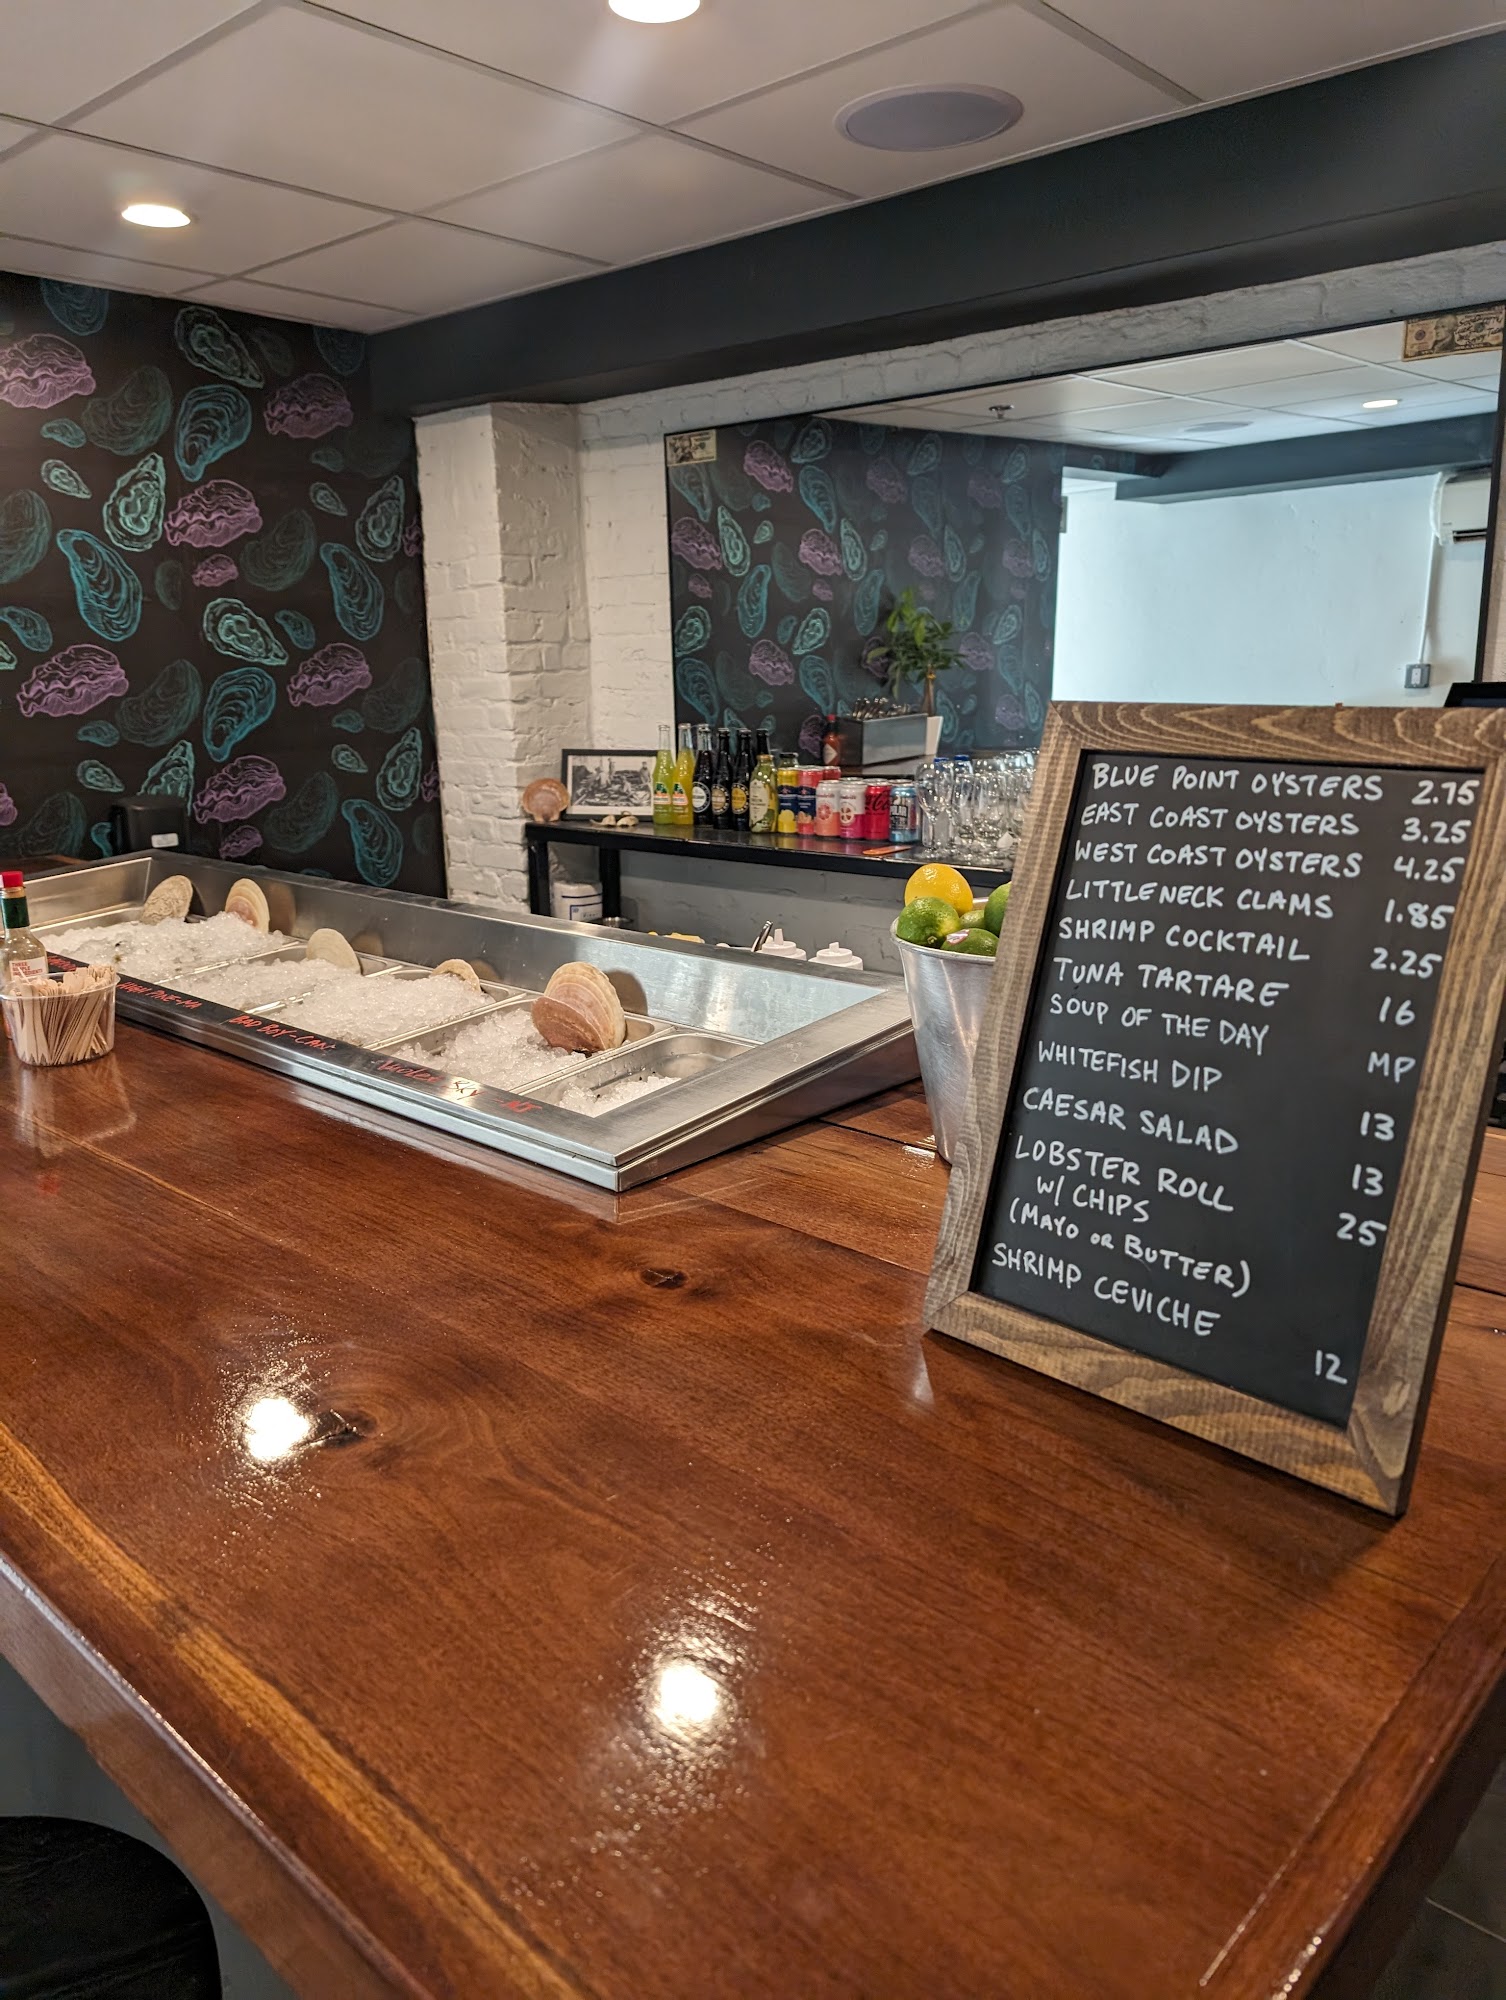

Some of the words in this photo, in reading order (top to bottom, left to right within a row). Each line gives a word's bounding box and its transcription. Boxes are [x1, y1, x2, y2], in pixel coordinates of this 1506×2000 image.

[1092, 762, 1160, 790] BLUE
[1171, 765, 1240, 791] POINT
[1251, 770, 1384, 802] OYSTERS
[1411, 779, 1481, 806] 2.75
[1080, 801, 1140, 826] EAST
[1149, 805, 1229, 829] COAST
[1235, 810, 1360, 836] OYSTERS
[1401, 816, 1472, 844] 3.25
[1074, 839, 1139, 864] WEST
[1146, 843, 1227, 867] COAST
[1235, 847, 1363, 878] OYSTERS
[1393, 855, 1466, 884] 4.25
[1065, 878, 1225, 909] LITTLENECK
[1236, 888, 1334, 919] CLAMS
[1384, 898, 1456, 930] 1.85
[1058, 916, 1156, 943] SHRIMP
[1165, 924, 1311, 961] COCKTAIL
[1053, 956, 1125, 987] TUNA
[1137, 963, 1290, 1007] TARTARE
[1370, 947, 1443, 979] 2.25
[1049, 993, 1109, 1025] SOUP
[1120, 1006, 1153, 1028] OF
[1160, 1012, 1211, 1038] THE
[1219, 1019, 1270, 1056] DAY
[1379, 996, 1415, 1026] 16
[1038, 1040, 1159, 1084] WHITEFISH
[1171, 1059, 1223, 1092] DIP
[1367, 1051, 1416, 1083] MP
[1023, 1086, 1127, 1131] CAESAR
[1139, 1109, 1239, 1155] SALAD
[1360, 1111, 1395, 1141] 13
[1014, 1134, 1141, 1186] LOBSTER
[1157, 1167, 1234, 1212] ROLL
[1352, 1163, 1383, 1196] 13
[1072, 1183, 1150, 1223] CHIPS
[1337, 1212, 1387, 1246] 25
[1124, 1233, 1251, 1298] BUTTER)
[991, 1242, 1082, 1290] SHRIMP
[1093, 1276, 1221, 1336] CEVICHE
[1315, 1350, 1348, 1385] 12
